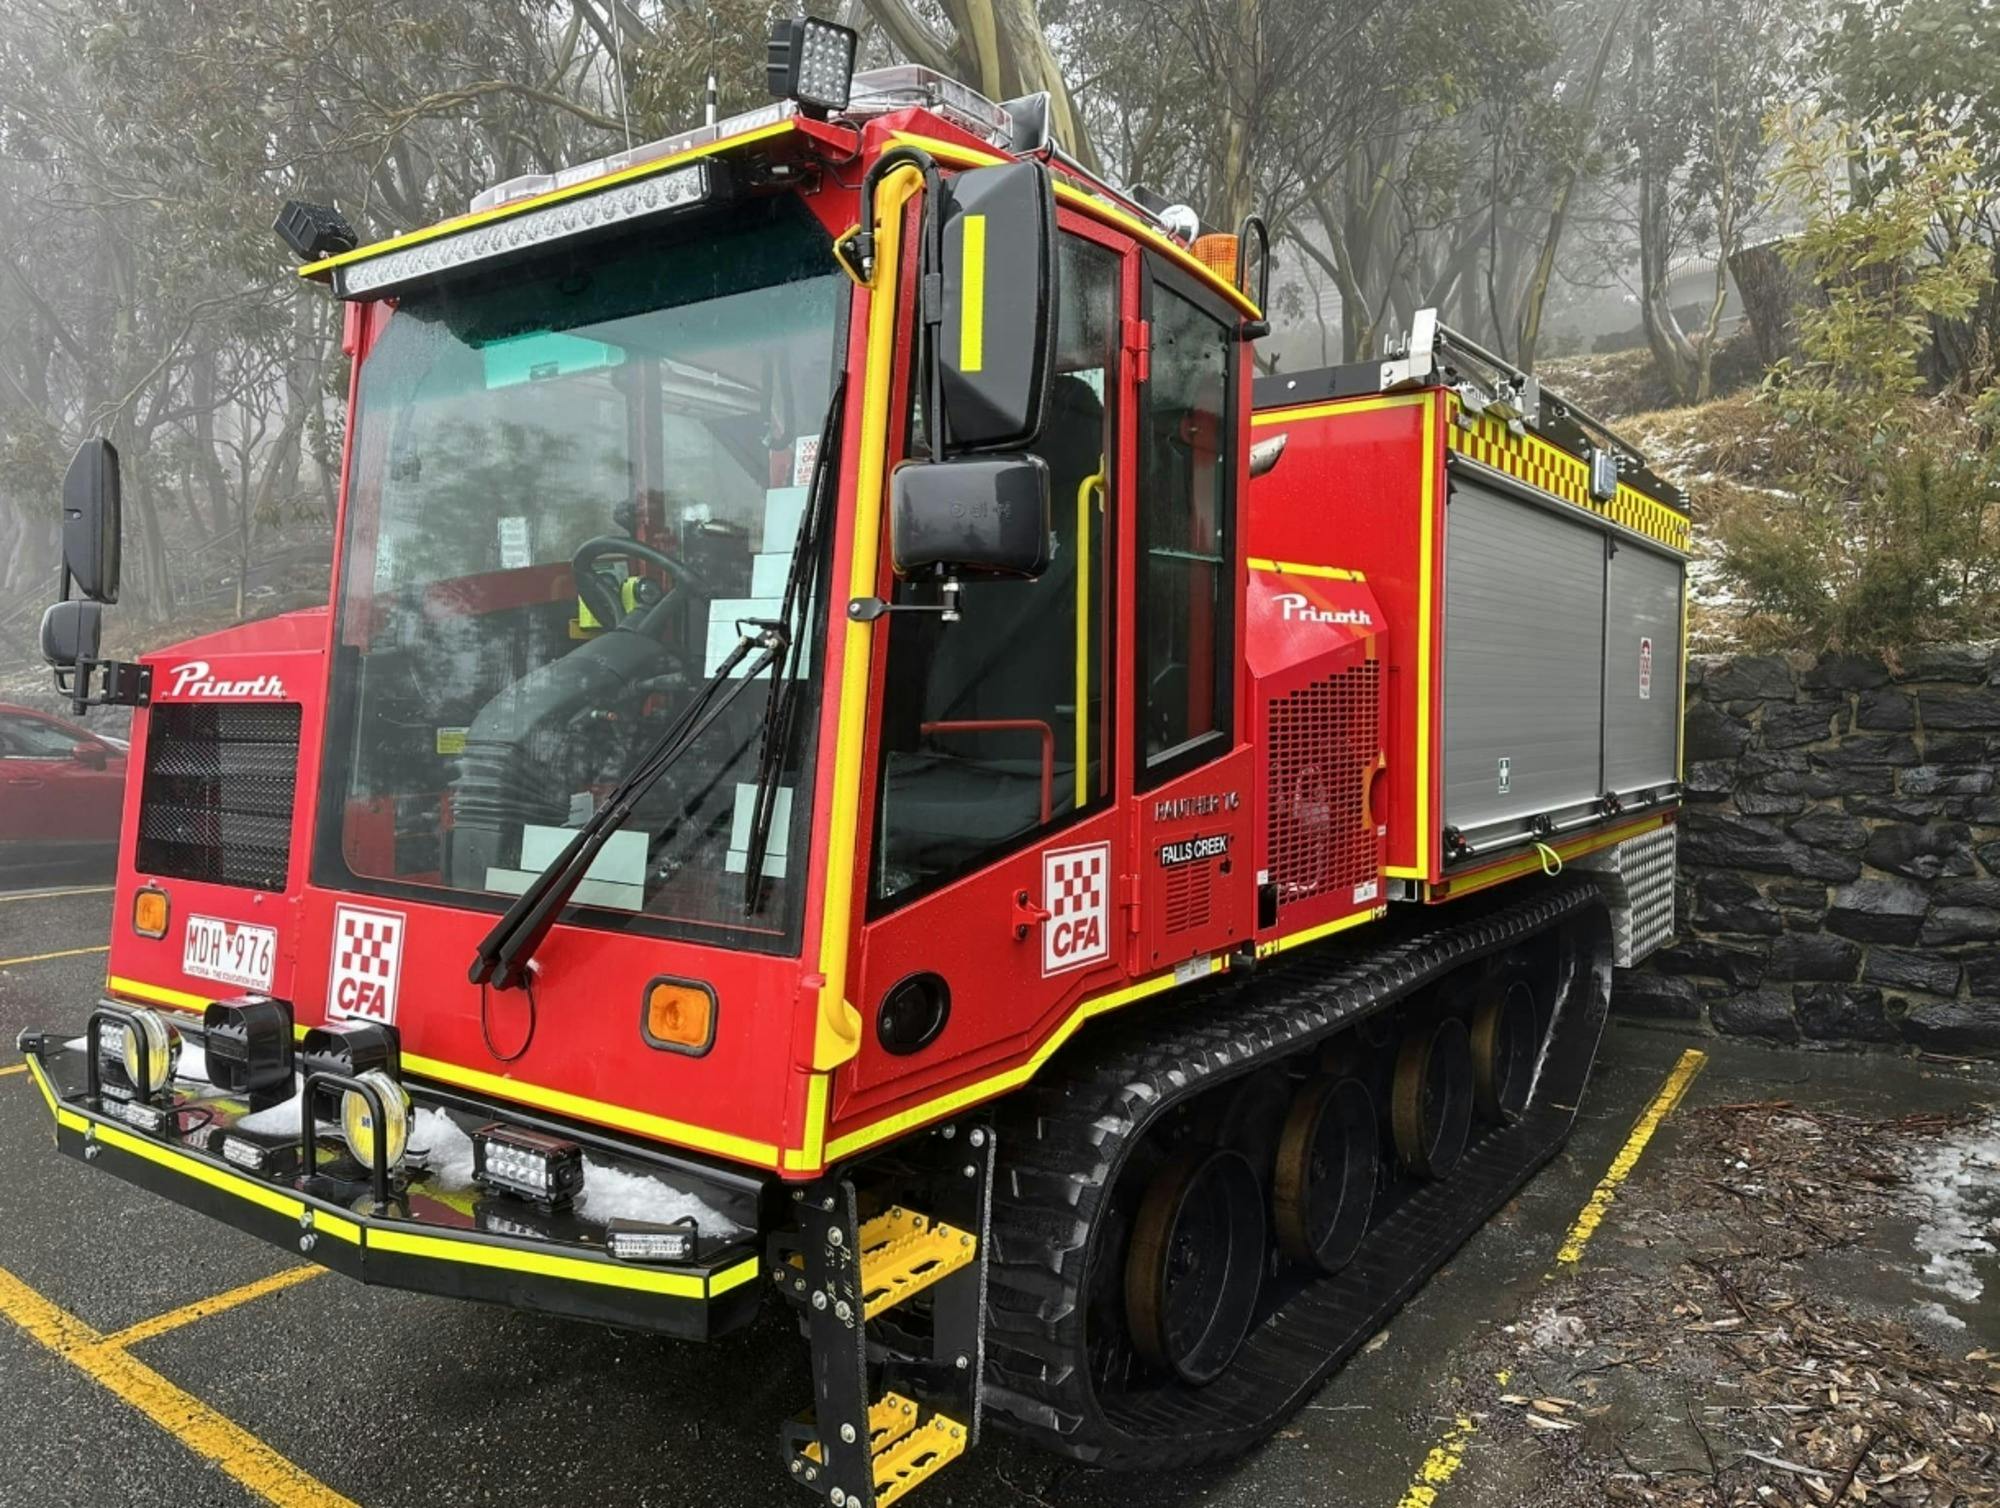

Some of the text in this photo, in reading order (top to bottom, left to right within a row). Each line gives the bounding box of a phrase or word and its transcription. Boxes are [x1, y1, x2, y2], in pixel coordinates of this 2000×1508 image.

[1272, 593, 1373, 625] Prinoth
[169, 661, 283, 697] Prinoth
[1162, 836, 1227, 865] FALLS CREEK
[186, 924, 269, 976] MDH 976
[1052, 915, 1100, 958] CFA
[337, 977, 385, 1019] CFA
